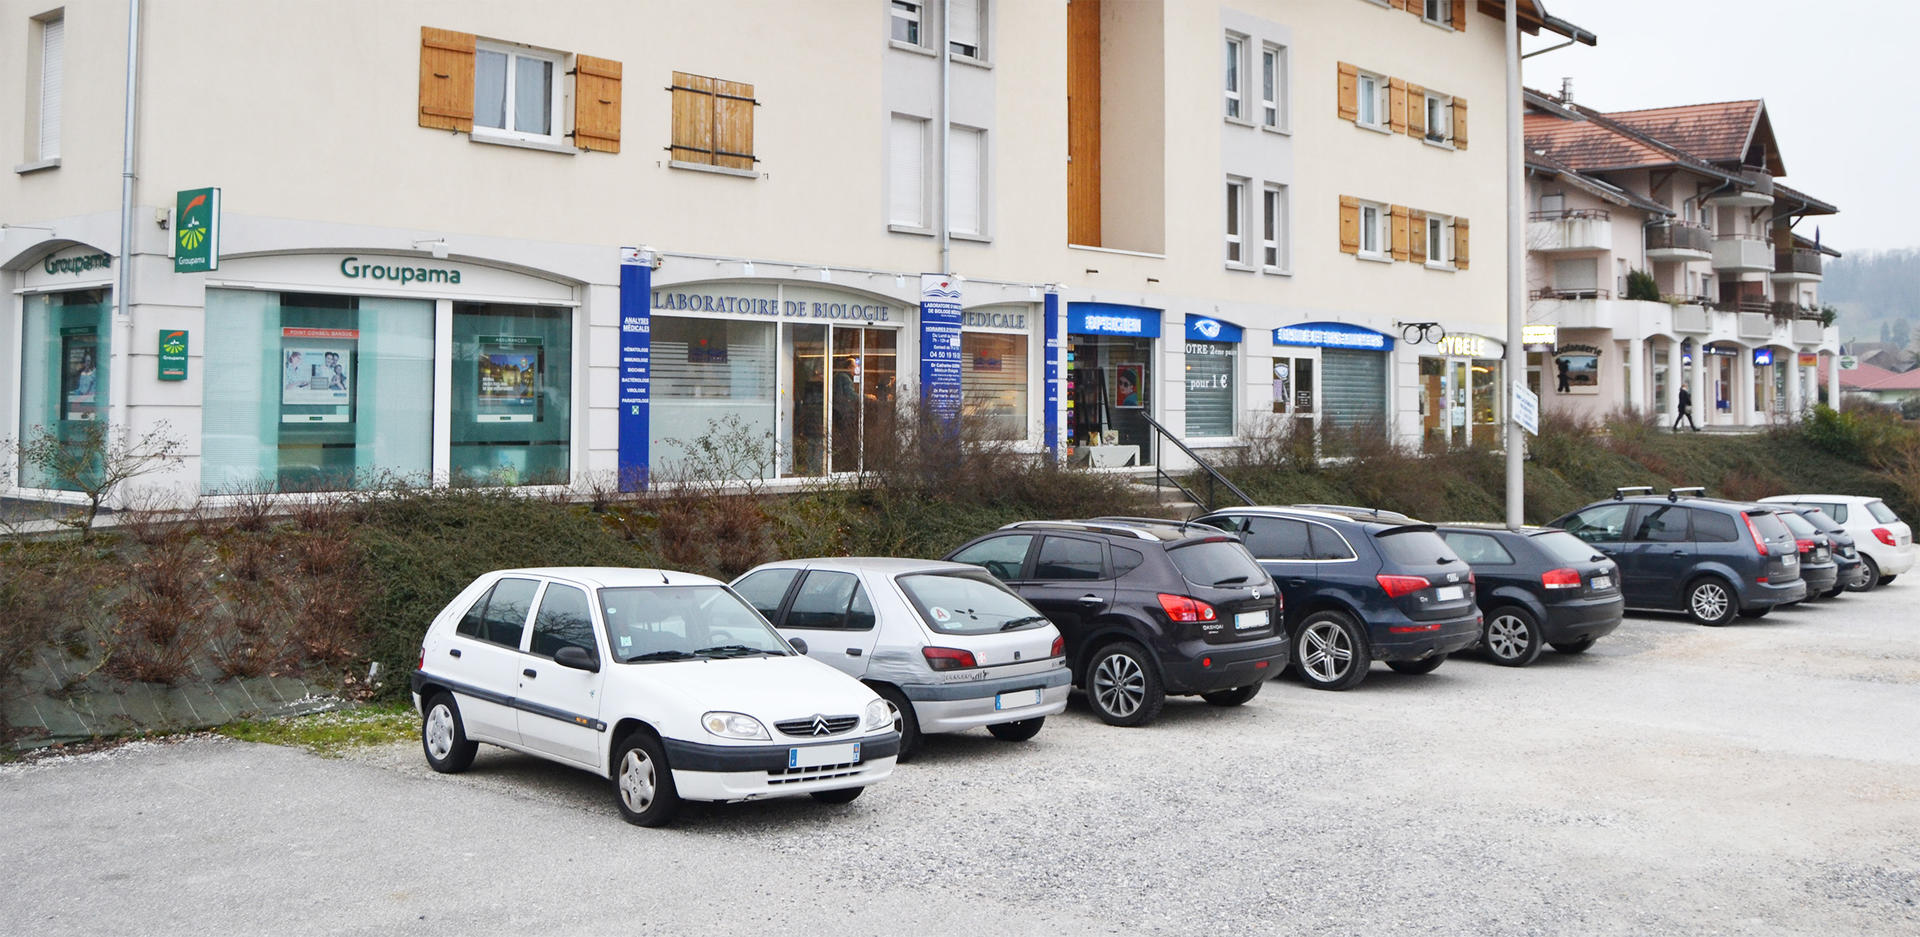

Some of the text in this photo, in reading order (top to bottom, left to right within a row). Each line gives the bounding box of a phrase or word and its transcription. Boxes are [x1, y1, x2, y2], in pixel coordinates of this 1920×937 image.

[44, 252, 112, 276] Groupama
[178, 256, 206, 267] Groupama
[340, 257, 462, 285] Groupama
[653, 291, 779, 316] LABORATOIRE
[783, 299, 807, 317] DE
[812, 302, 889, 321] BIOLOGIE
[1185, 343, 1208, 354] OTRE
[1190, 374, 1228, 391] pour 1 €
[936, 608, 948, 619] A
